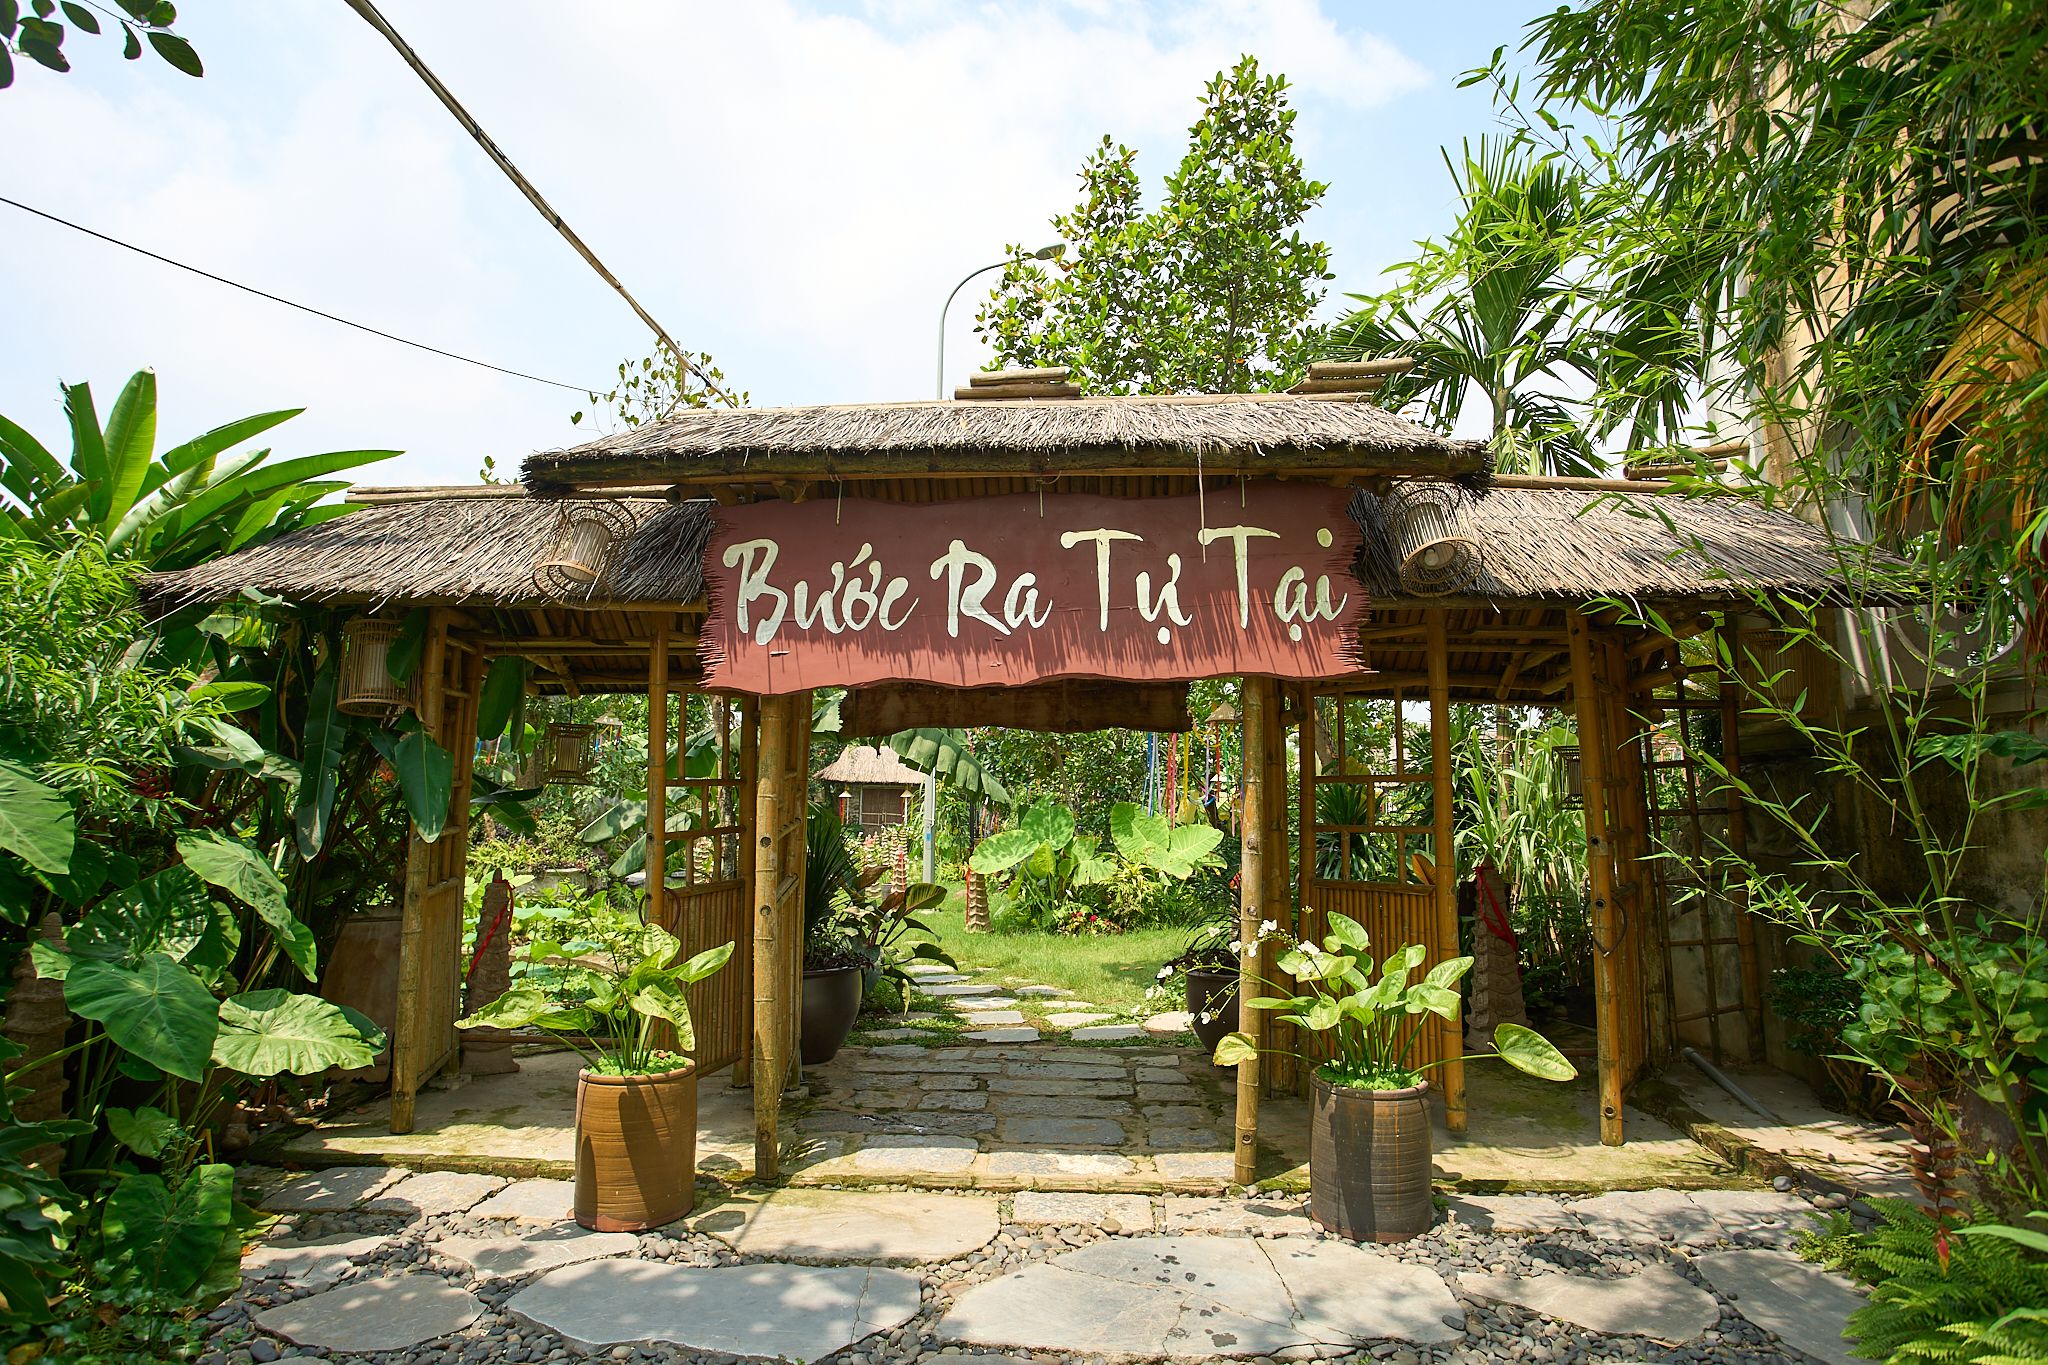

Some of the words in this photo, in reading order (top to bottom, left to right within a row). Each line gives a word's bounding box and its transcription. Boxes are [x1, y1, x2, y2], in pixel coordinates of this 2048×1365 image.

[722, 538, 919, 646] Bước
[929, 539, 1053, 638] Ra
[1060, 527, 1194, 646] Tự
[1197, 525, 1348, 642] Tại
